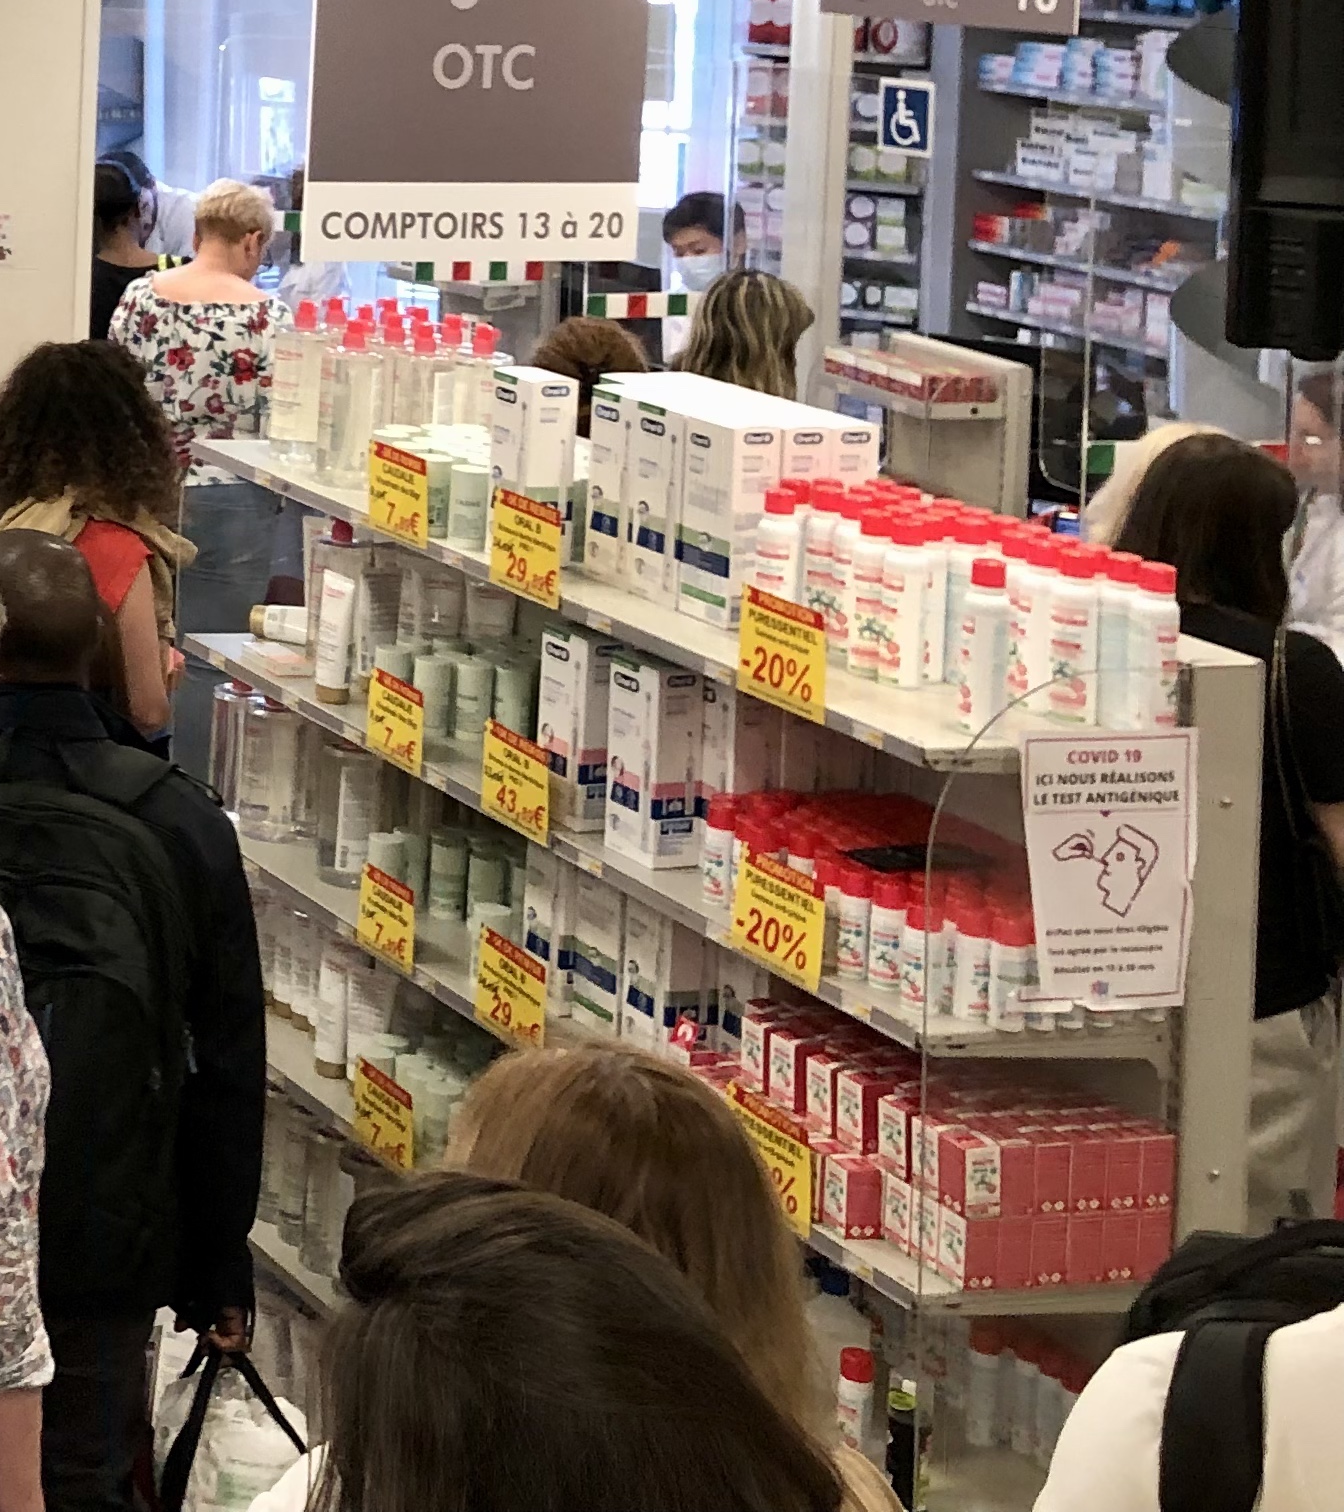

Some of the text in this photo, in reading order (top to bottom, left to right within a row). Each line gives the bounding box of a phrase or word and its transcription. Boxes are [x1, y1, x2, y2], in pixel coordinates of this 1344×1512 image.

[432, 42, 536, 90] OTC
[321, 211, 624, 240] COMPTOIRS 13 à 20
[742, 646, 812, 703] -20%
[1067, 749, 1142, 764] COVID 19
[1036, 769, 1175, 786] ICI NOUS RÉALISONS
[1034, 789, 1180, 805] LE TEST ANTIGÉNIQUE
[736, 907, 807, 970] -20%
